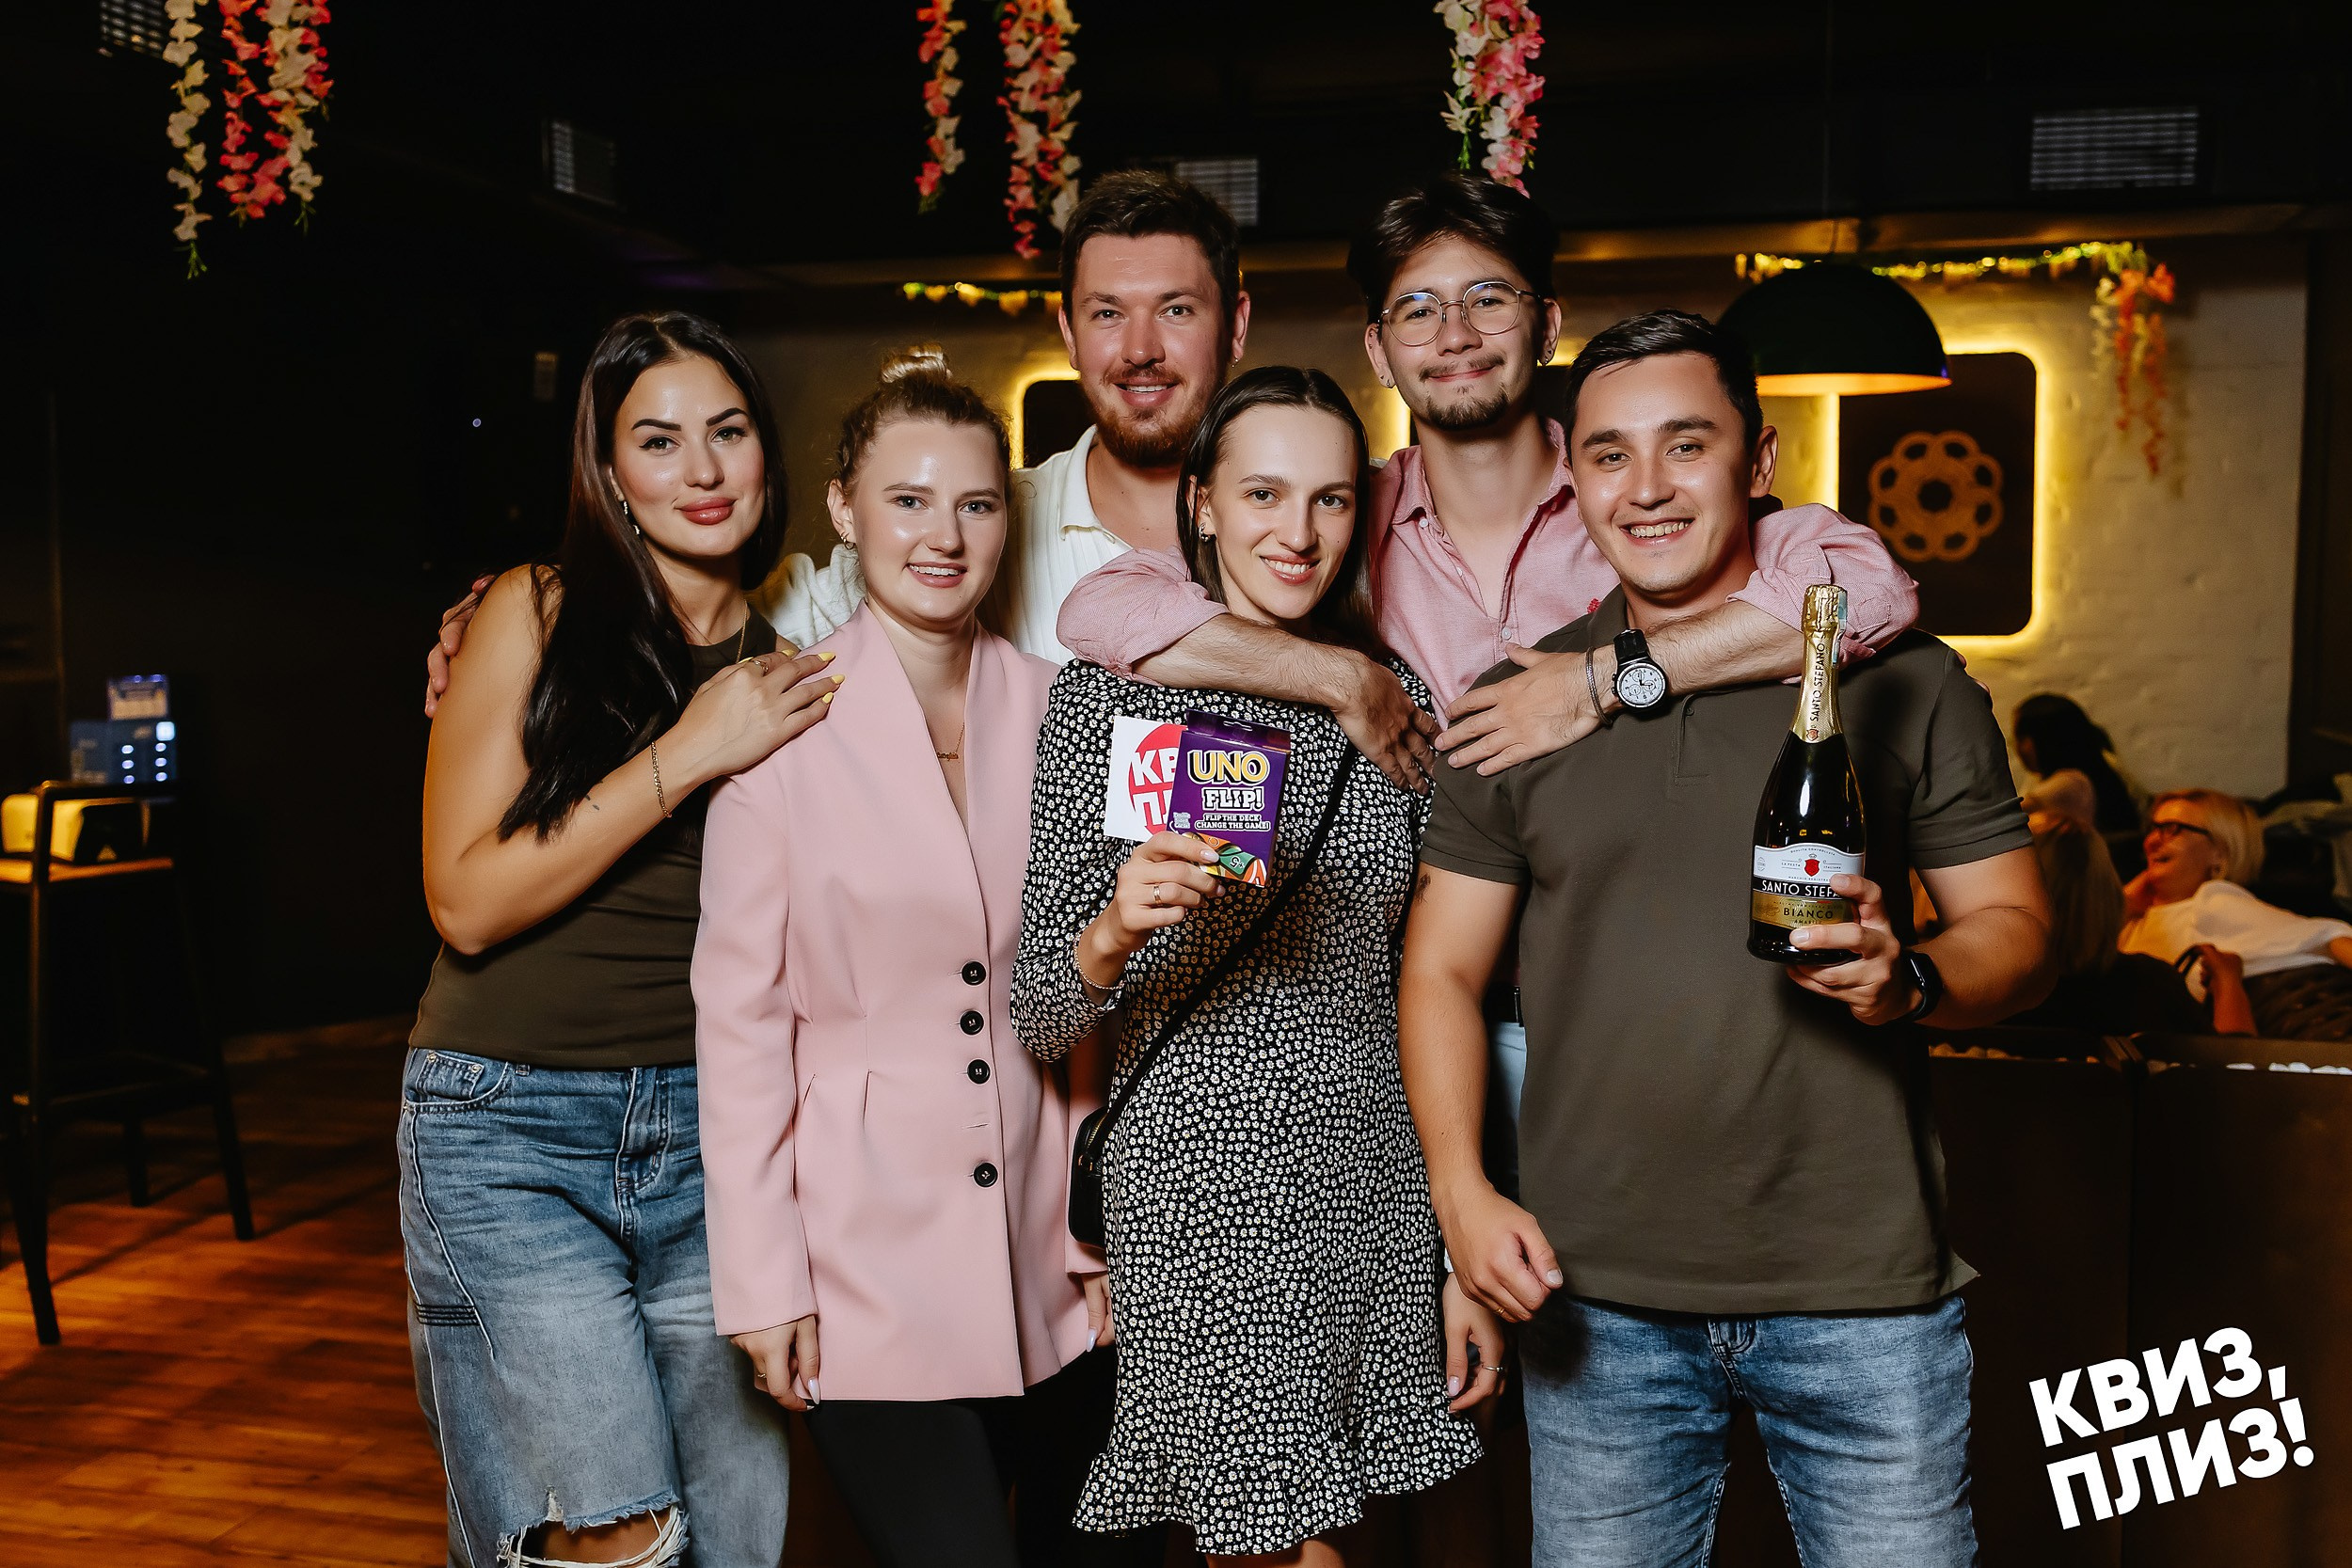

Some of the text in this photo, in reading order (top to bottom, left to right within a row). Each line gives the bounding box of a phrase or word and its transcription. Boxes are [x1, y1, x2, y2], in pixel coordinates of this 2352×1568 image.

[1814, 642, 1825, 687] STEFANO
[1810, 689, 1821, 721] SANTO
[1188, 751, 1269, 784] UNO
[1204, 788, 1263, 810] FLIP!
[1205, 814, 1222, 822] FLIP
[1762, 879, 1800, 895] SANTO
[1783, 908, 1834, 919] BIANCO
